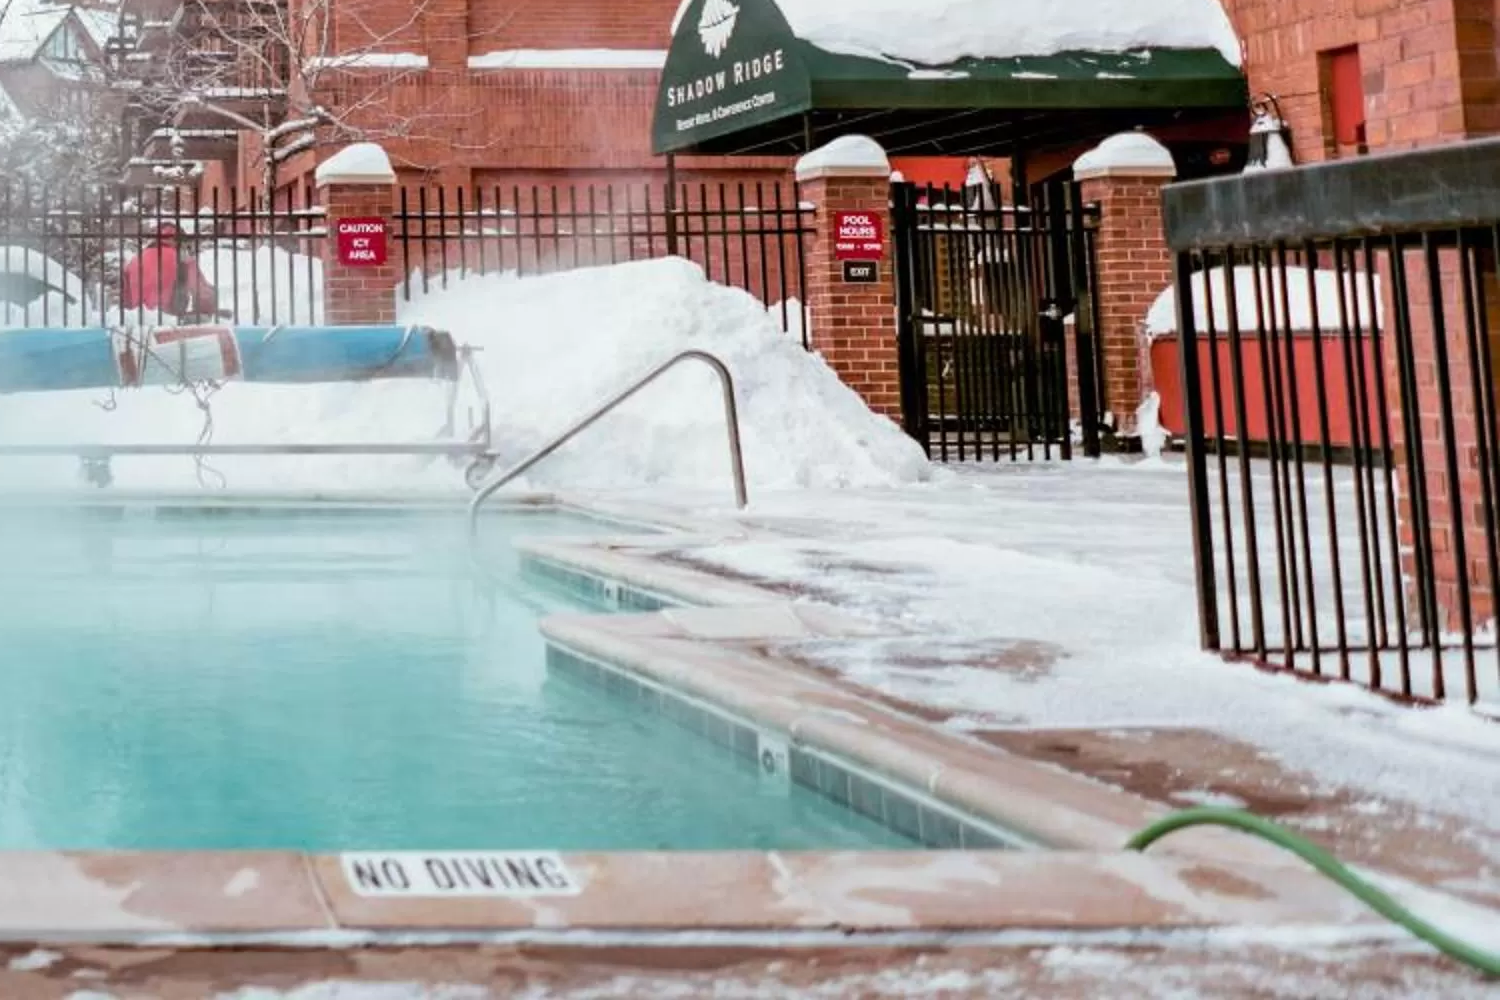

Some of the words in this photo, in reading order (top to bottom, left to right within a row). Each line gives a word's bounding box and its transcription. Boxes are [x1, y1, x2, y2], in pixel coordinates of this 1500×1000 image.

[734, 49, 784, 86] RIDGE
[843, 215, 872, 225] POOL
[339, 223, 384, 233] CAUTION
[840, 226, 876, 236] HOURS
[349, 250, 377, 260] AREA
[849, 267, 870, 277] EXIT
[351, 858, 411, 889] NO
[423, 857, 569, 889] DIVING
